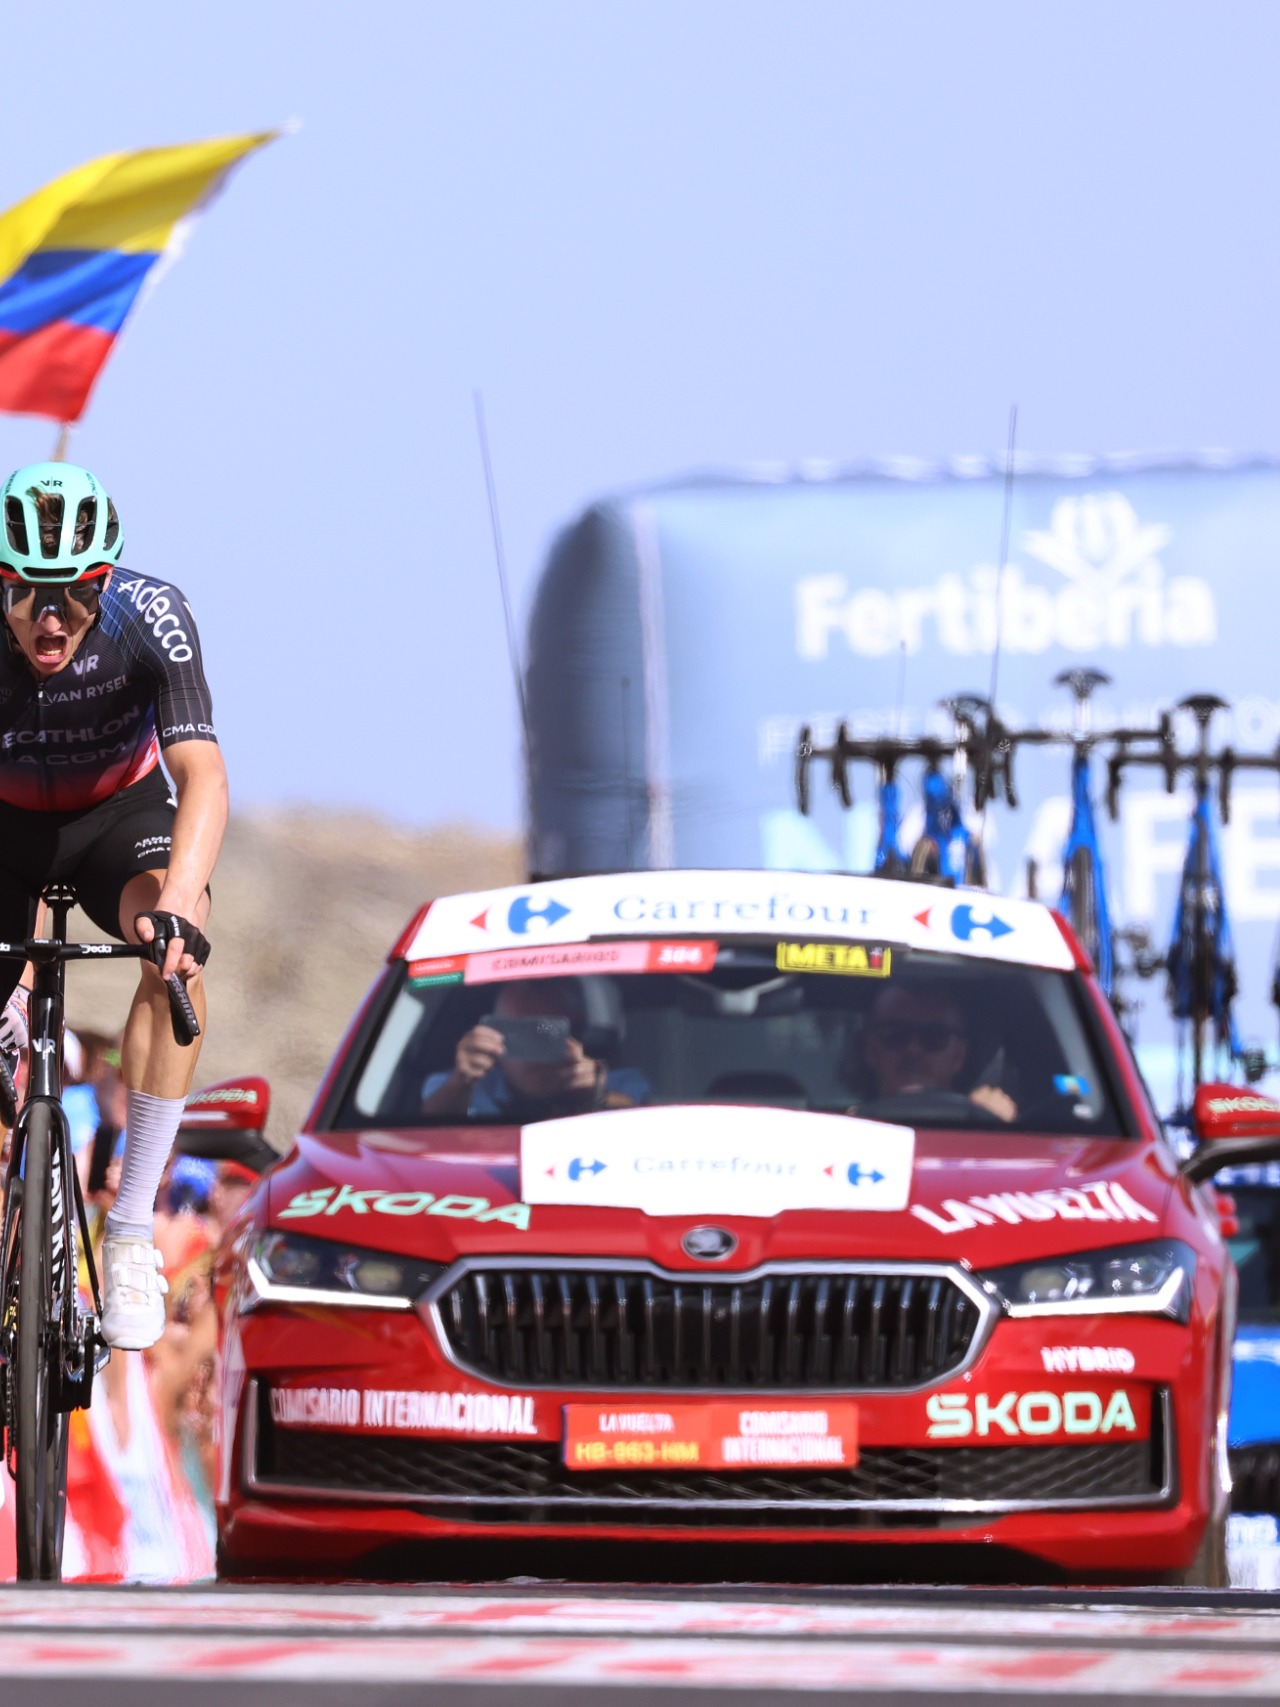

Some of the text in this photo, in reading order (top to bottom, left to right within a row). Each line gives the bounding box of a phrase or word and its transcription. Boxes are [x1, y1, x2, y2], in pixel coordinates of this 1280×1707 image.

[117, 578, 193, 663] Adecco
[797, 568, 1216, 658] Fertiberia
[51, 674, 131, 703] VAN RYSEL
[162, 723, 217, 738] CMA CG
[612, 893, 877, 925] Carrefour
[785, 943, 870, 968] META
[633, 1156, 798, 1177] Carrefour
[1040, 1346, 1135, 1374] HYBRID
[270, 1388, 538, 1434] COMISARIO INTERNACIONAL
[617, 1413, 675, 1433] VUELTA
[722, 1436, 845, 1463] INTERNACIONAL
